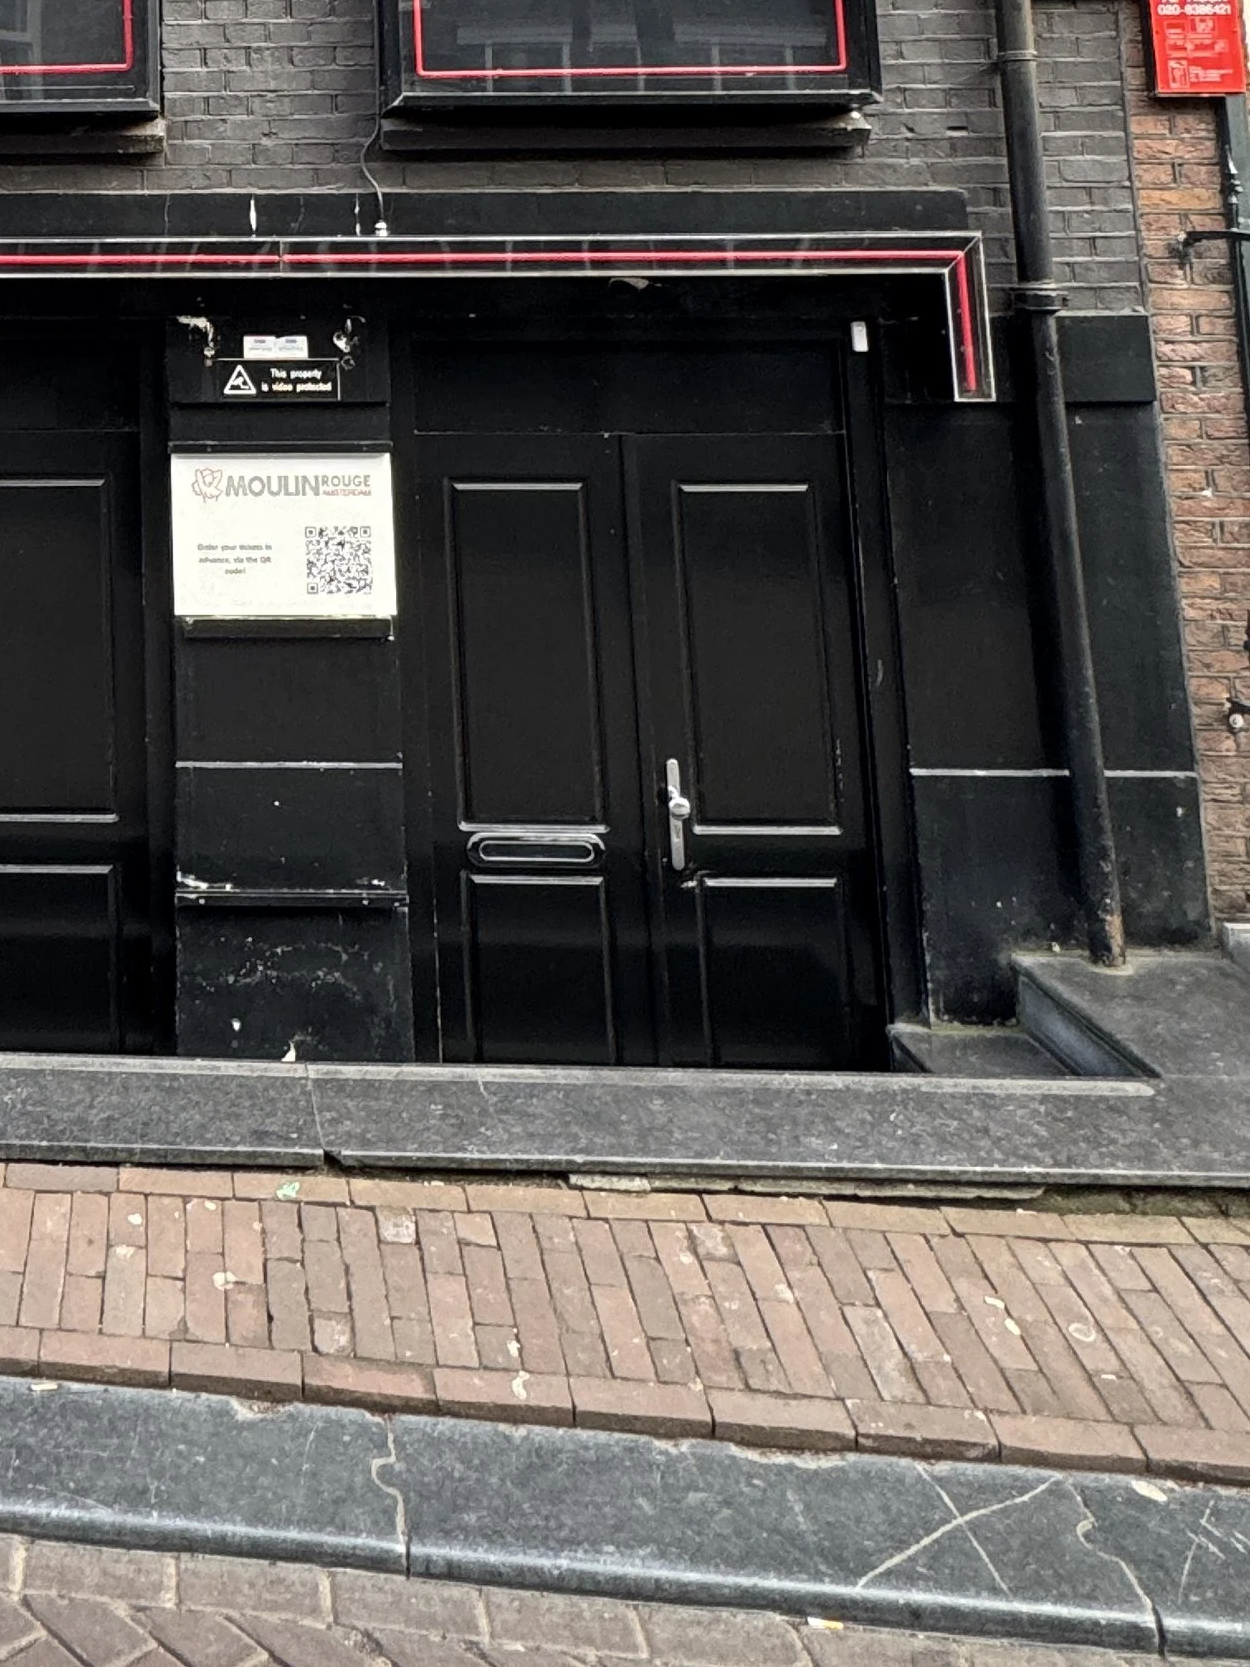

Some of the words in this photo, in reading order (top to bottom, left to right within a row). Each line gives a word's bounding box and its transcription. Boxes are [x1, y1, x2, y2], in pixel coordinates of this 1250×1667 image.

[270, 367, 287, 379] This
[290, 368, 322, 380] property
[261, 381, 269, 392] is
[271, 381, 293, 391] video
[295, 381, 332, 393] protected
[225, 475, 320, 497] MOULIN
[321, 474, 371, 487] ROUGE
